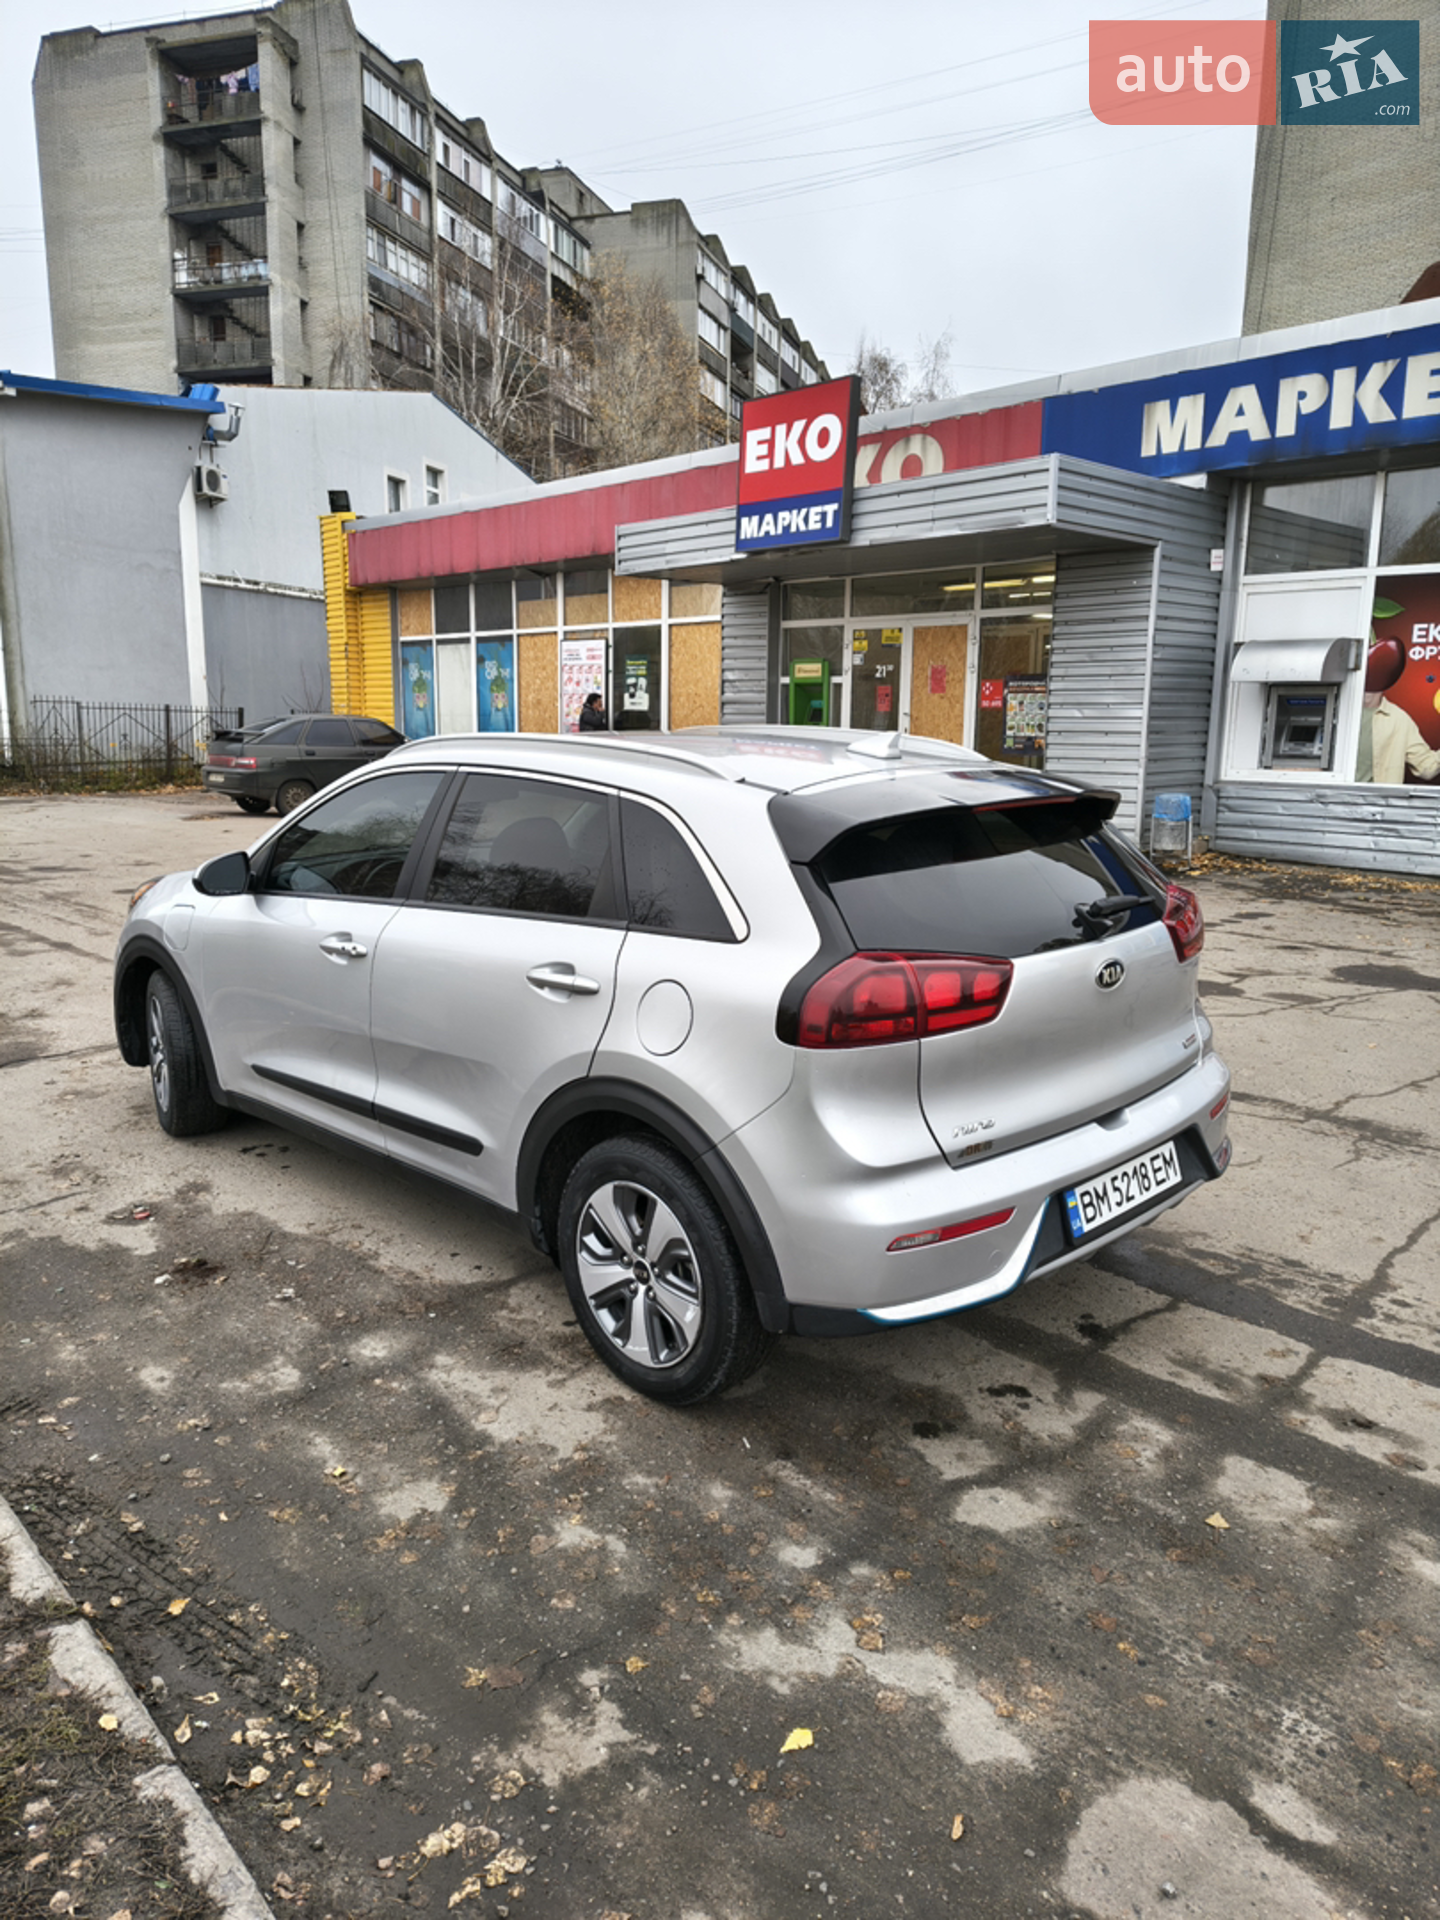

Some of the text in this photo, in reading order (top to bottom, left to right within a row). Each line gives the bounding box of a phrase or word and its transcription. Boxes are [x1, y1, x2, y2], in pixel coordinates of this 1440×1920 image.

[1140, 351, 1440, 458] МАРКЕ
[744, 413, 843, 474] ЕКО
[739, 502, 840, 540] МАРКЕТ
[1102, 964, 1122, 984] KIA
[1079, 1147, 1178, 1224] BM 5218 EM
